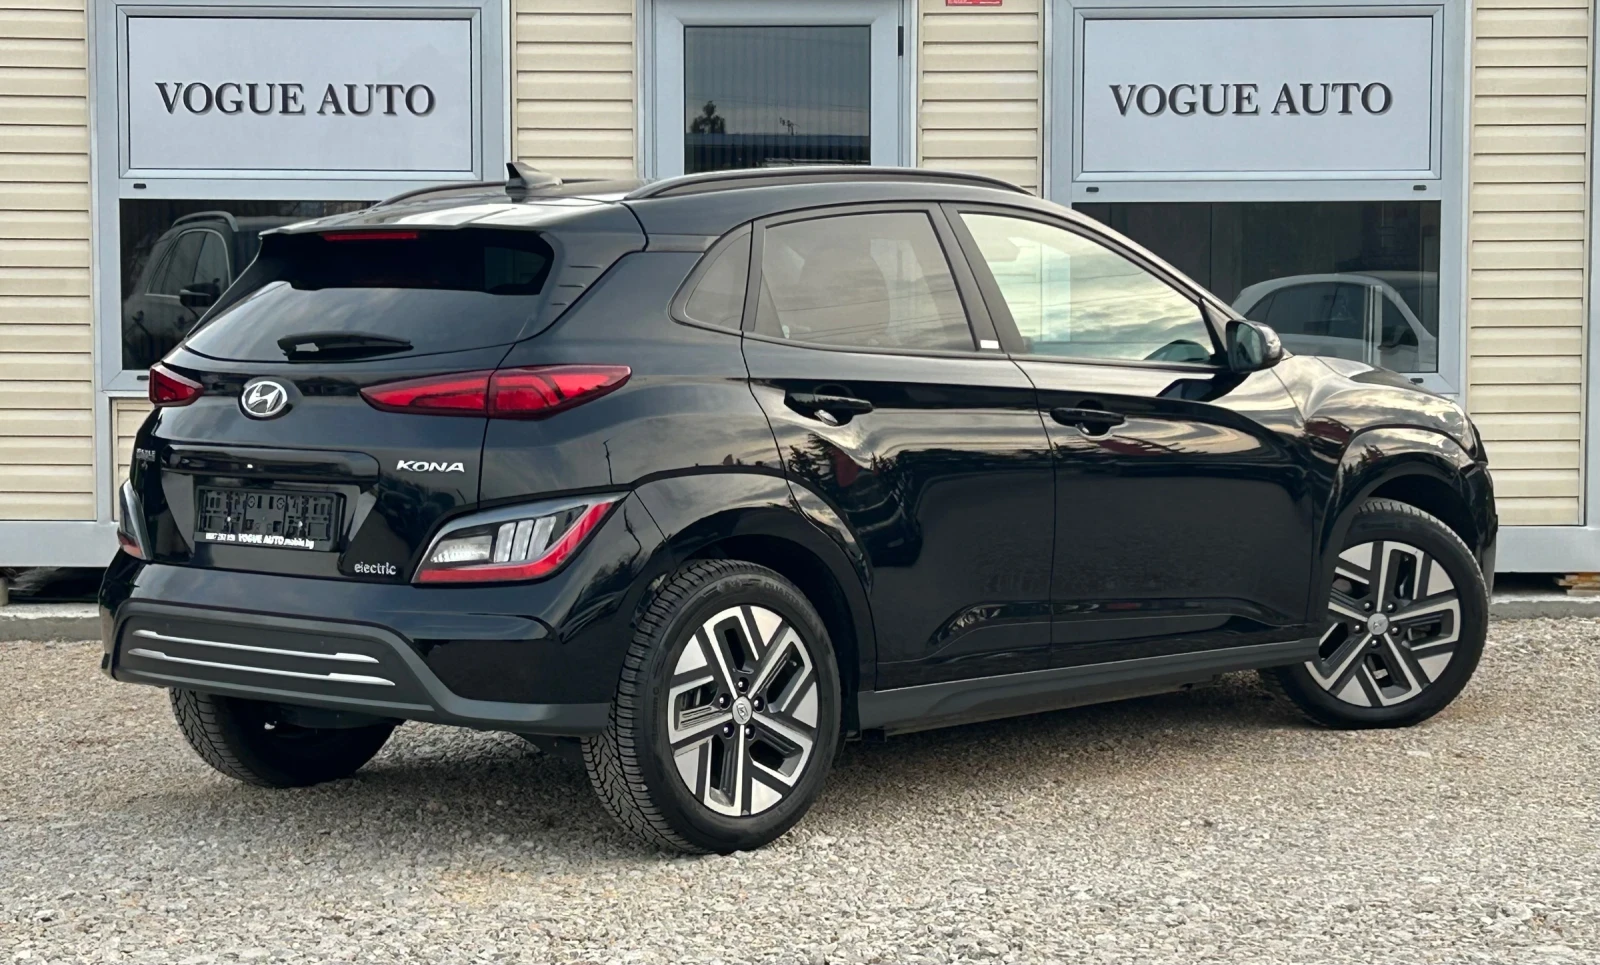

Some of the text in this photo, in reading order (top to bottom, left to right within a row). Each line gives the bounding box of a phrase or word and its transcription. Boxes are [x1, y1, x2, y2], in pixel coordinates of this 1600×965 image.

[155, 82, 436, 116] VOGUE AUTO
[1109, 82, 1393, 116] VOGUE AUTO
[396, 459, 465, 473] KONA
[238, 534, 263, 545] VOGUE
[263, 535, 284, 546] AUTO
[354, 561, 397, 575] electric
